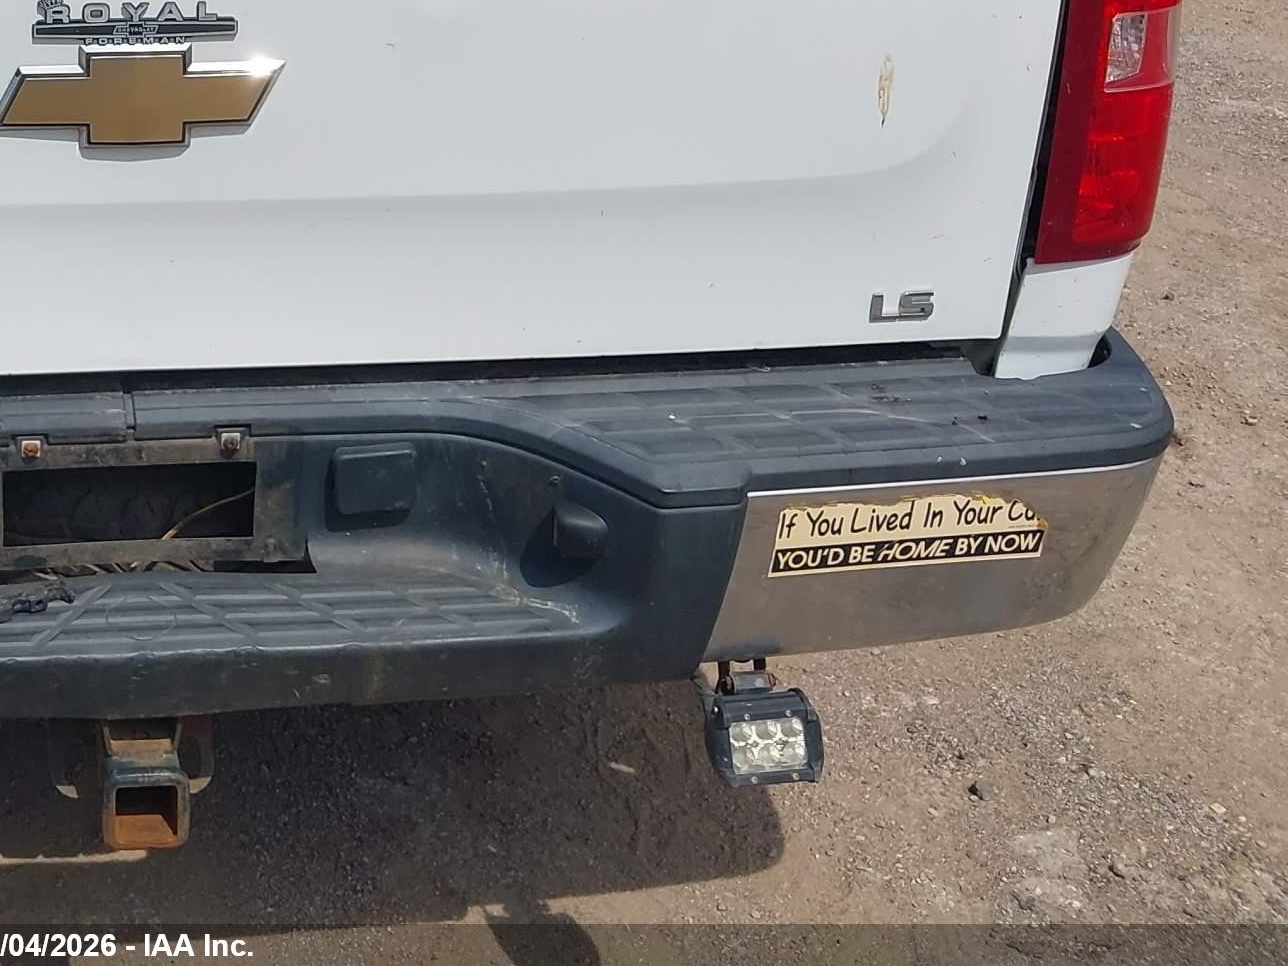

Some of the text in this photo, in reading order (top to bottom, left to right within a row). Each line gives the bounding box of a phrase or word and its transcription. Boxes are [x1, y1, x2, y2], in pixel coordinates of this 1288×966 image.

[45, 0, 218, 24] ROYAL
[85, 36, 186, 45] FOREMAN
[869, 291, 934, 323] LS
[778, 513, 798, 539] If
[806, 510, 844, 536] You
[850, 500, 915, 533] Lived
[923, 502, 943, 528] In
[953, 499, 1003, 525] Your
[777, 532, 1041, 569] YOU'D BE HOME BY NOW
